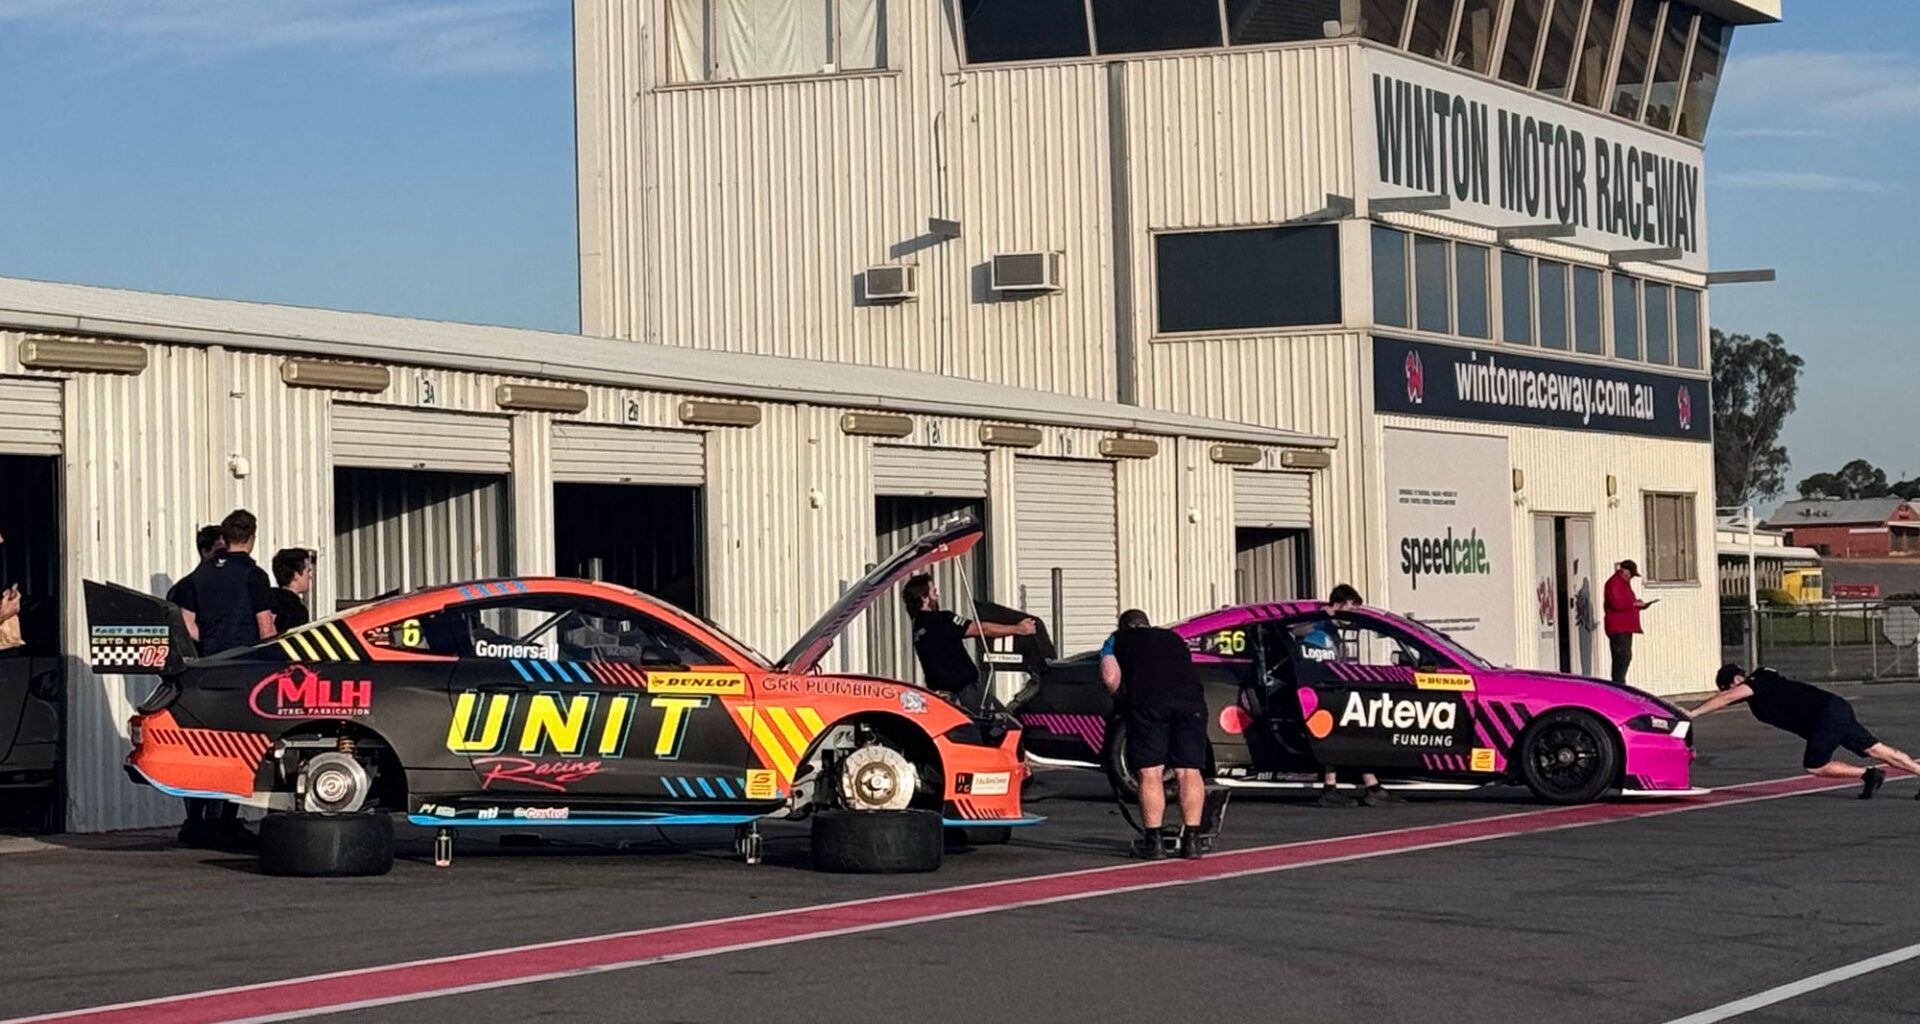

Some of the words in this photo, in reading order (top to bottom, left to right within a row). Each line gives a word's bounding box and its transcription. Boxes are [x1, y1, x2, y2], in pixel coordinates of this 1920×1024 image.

[1372, 73, 1490, 205] WINTON
[1498, 109, 1588, 228] MOTOR
[1595, 137, 1698, 253] RACEWAY
[1455, 351, 1654, 425] wintonraceway.com.au
[1401, 527, 1490, 590] speedcafe.
[402, 619, 421, 647] 6
[1218, 630, 1246, 652] 56
[141, 645, 170, 667] 02
[1302, 645, 1335, 662] Logan
[277, 672, 372, 708] MLH
[667, 678, 741, 687] DUNLOP
[762, 677, 799, 692] GRK
[806, 679, 896, 699] PLUMBING
[1427, 677, 1471, 685] DUNLOP
[277, 708, 305, 716] STEEL
[308, 707, 370, 716] FABRICATION
[1339, 691, 1457, 730] Arteva
[446, 691, 709, 758] UNIT
[1392, 733, 1453, 747] FUNDING
[472, 756, 608, 792] Racing
